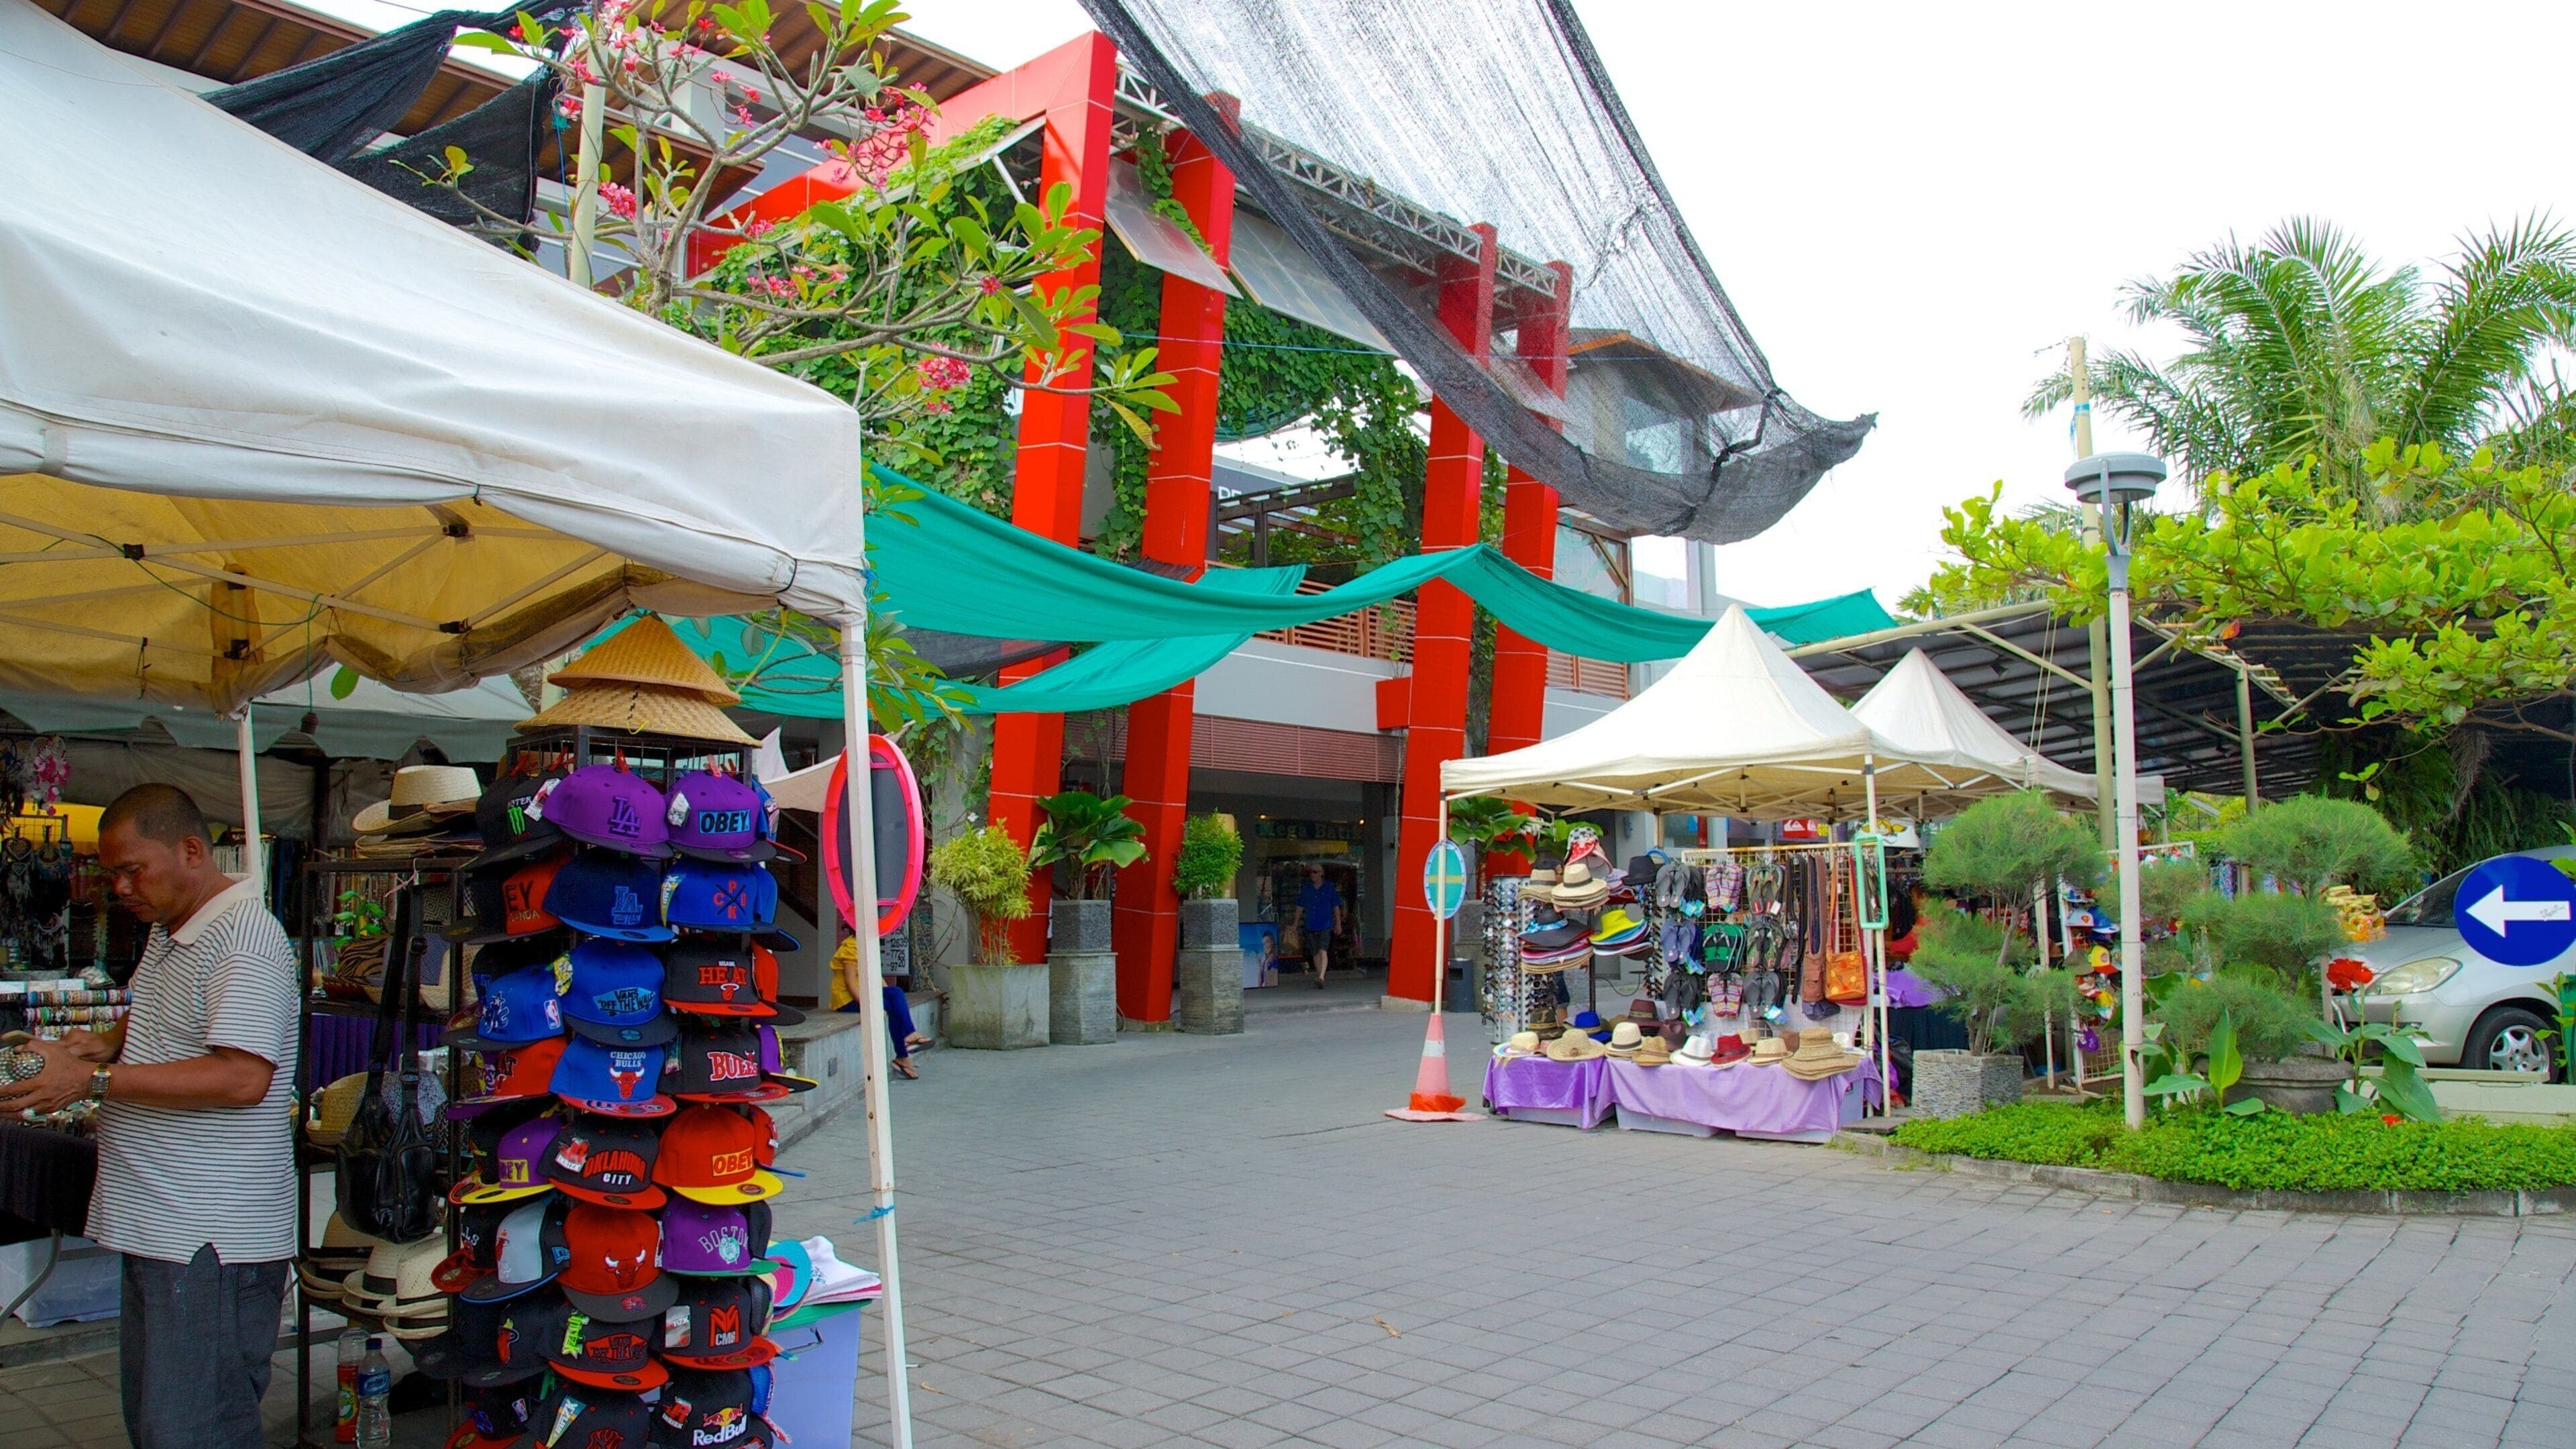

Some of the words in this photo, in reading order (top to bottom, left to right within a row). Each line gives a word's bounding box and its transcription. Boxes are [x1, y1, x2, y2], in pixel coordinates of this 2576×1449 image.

[701, 812, 749, 833] OBEY
[698, 966, 747, 985] HEAT
[610, 1051, 646, 1060] CHICAGO
[615, 1059, 642, 1068] BULLS
[712, 1149, 753, 1175] OBEY
[603, 1173, 632, 1185] CITY
